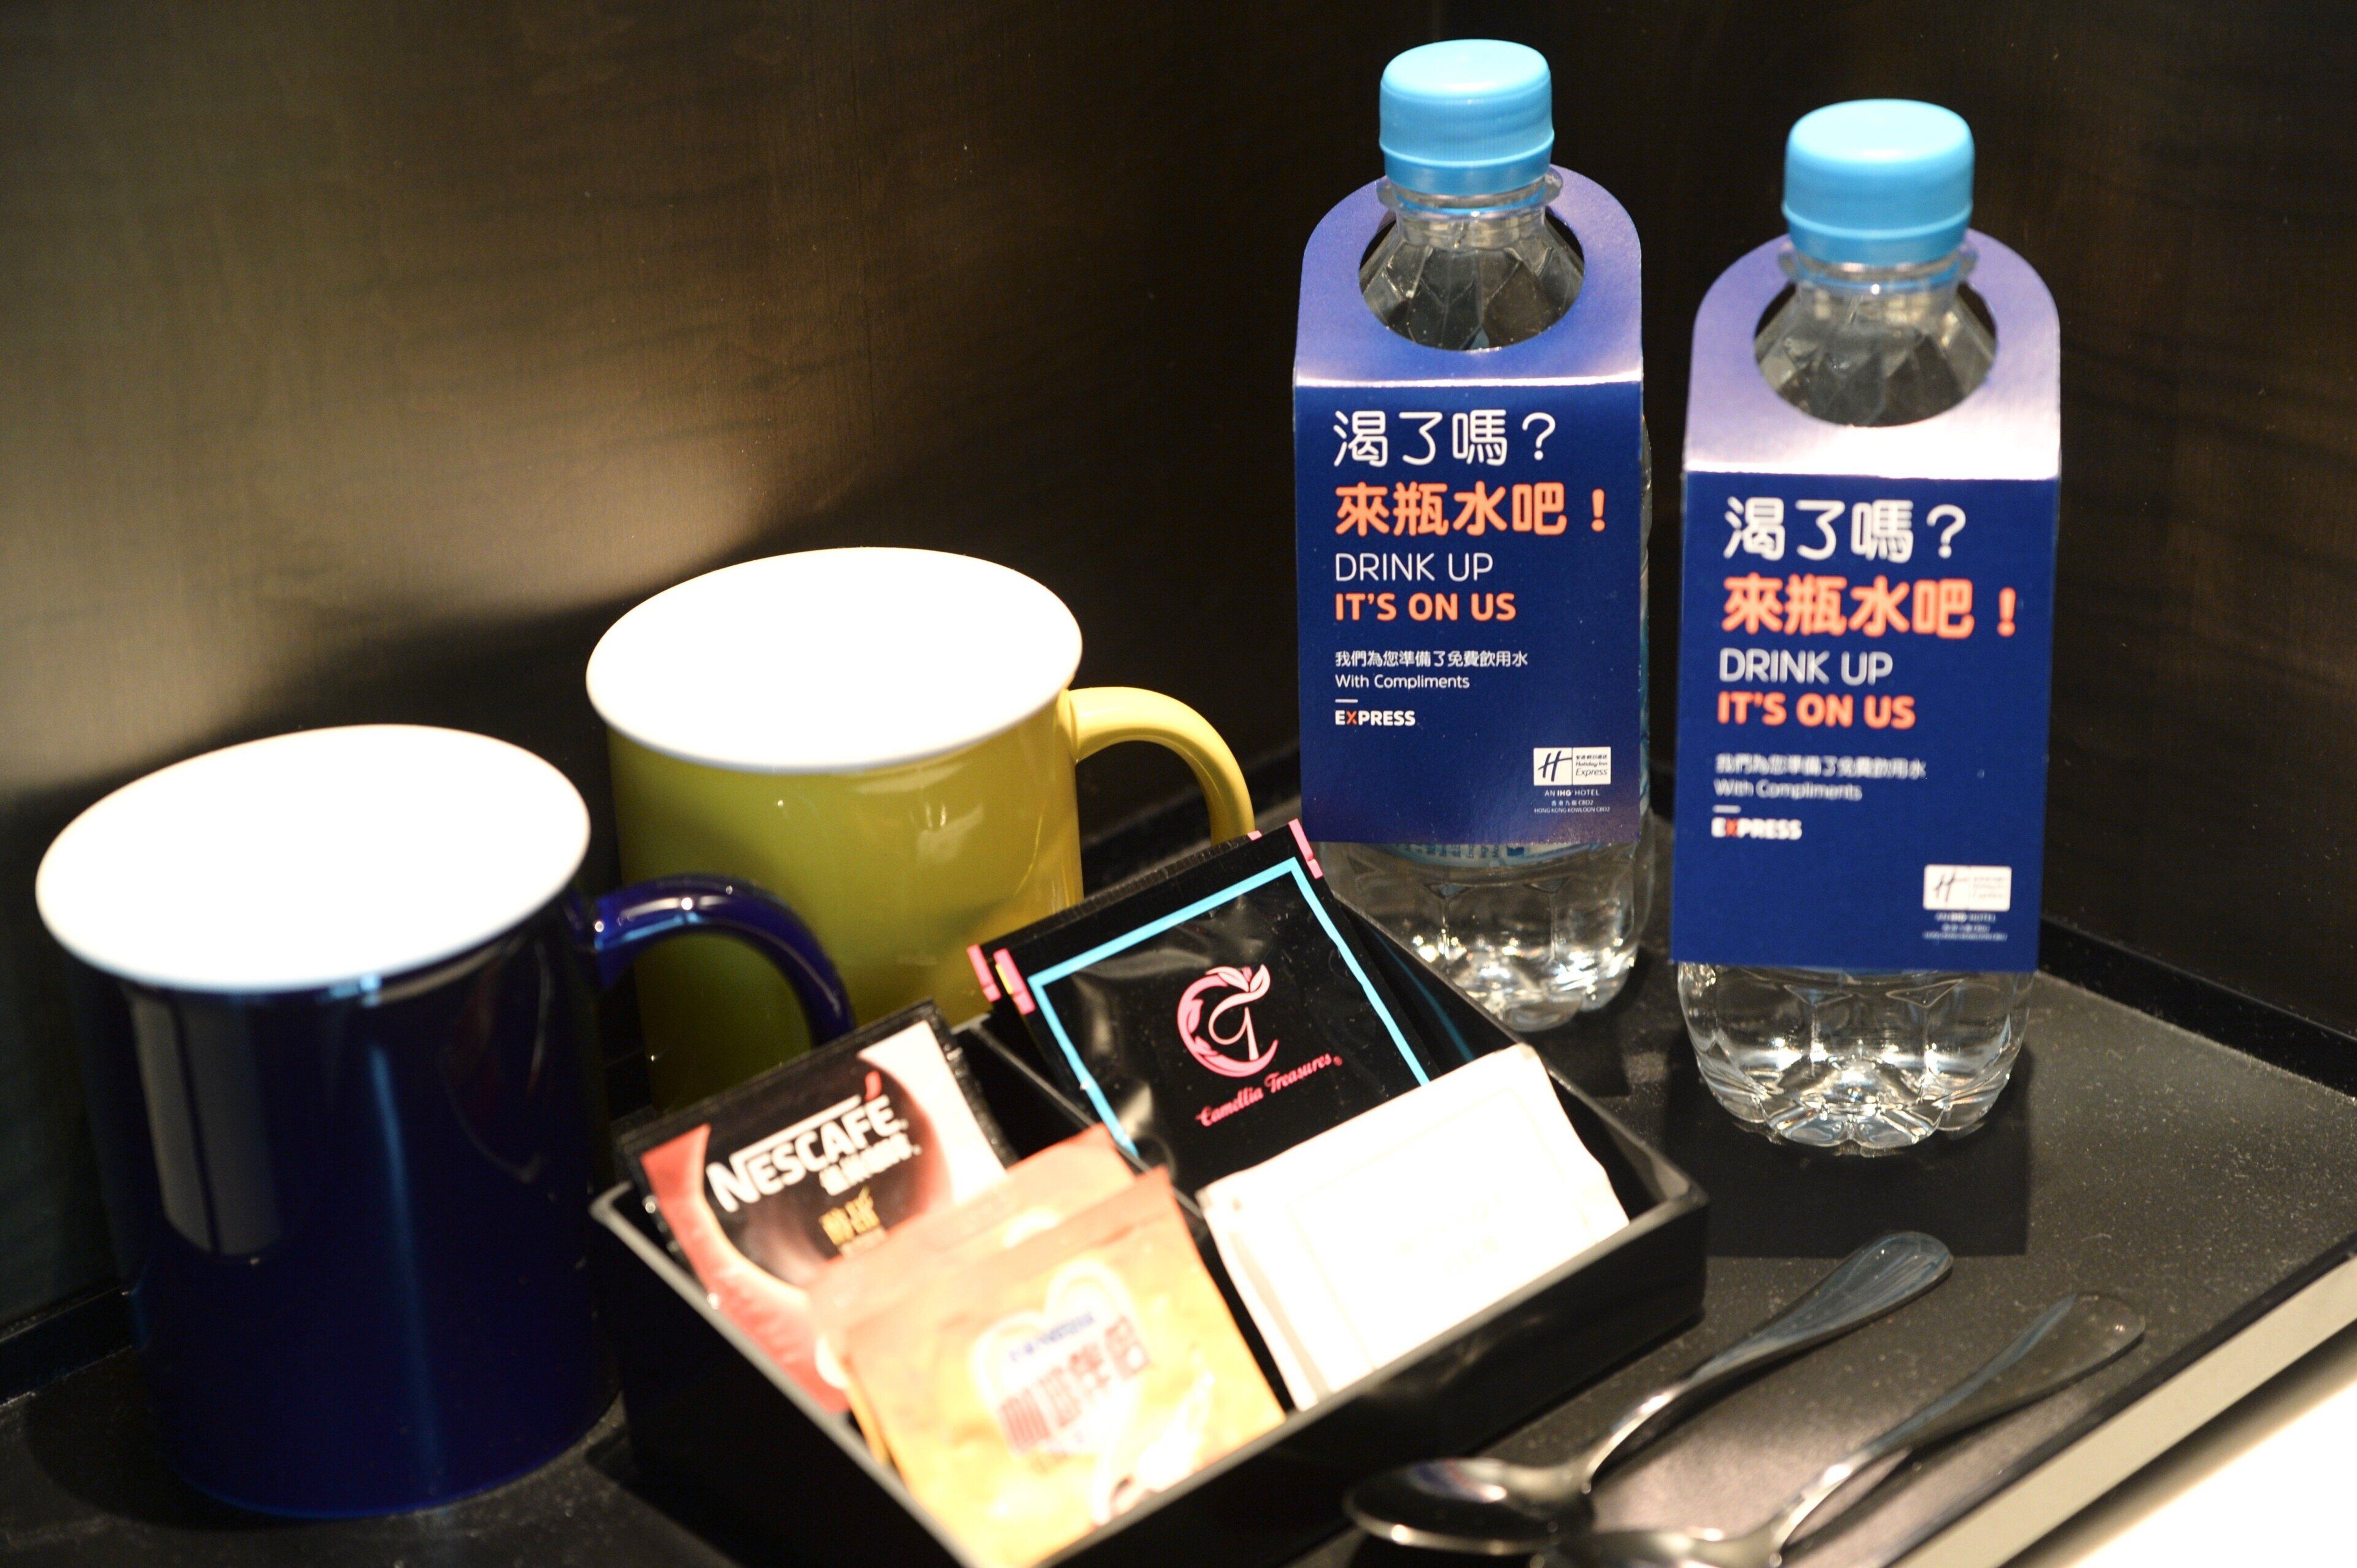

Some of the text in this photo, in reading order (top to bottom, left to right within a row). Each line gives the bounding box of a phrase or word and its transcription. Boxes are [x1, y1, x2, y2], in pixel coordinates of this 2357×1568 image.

[1333, 409, 1556, 467] 渴了嗎？
[1335, 481, 1606, 536] 來瓶水吧！
[1335, 553, 1493, 581] DRINK UP
[1335, 593, 1516, 621] IT'S ON US
[1722, 572, 2016, 639] 來瓶水吧！
[1335, 651, 1528, 668] 我們為您準備了免費飲用水
[1719, 648, 1893, 686] DRINK UP
[1335, 674, 1470, 690] With Compliments
[1335, 710, 1415, 726] EXPRESS
[1718, 691, 1916, 729] IT'S ON US
[1576, 768, 1608, 777] Express
[1713, 778, 1862, 801] With Compliments
[1711, 817, 1802, 840] EXPRESS
[1194, 1052, 1332, 1127] Camellia Treasures
